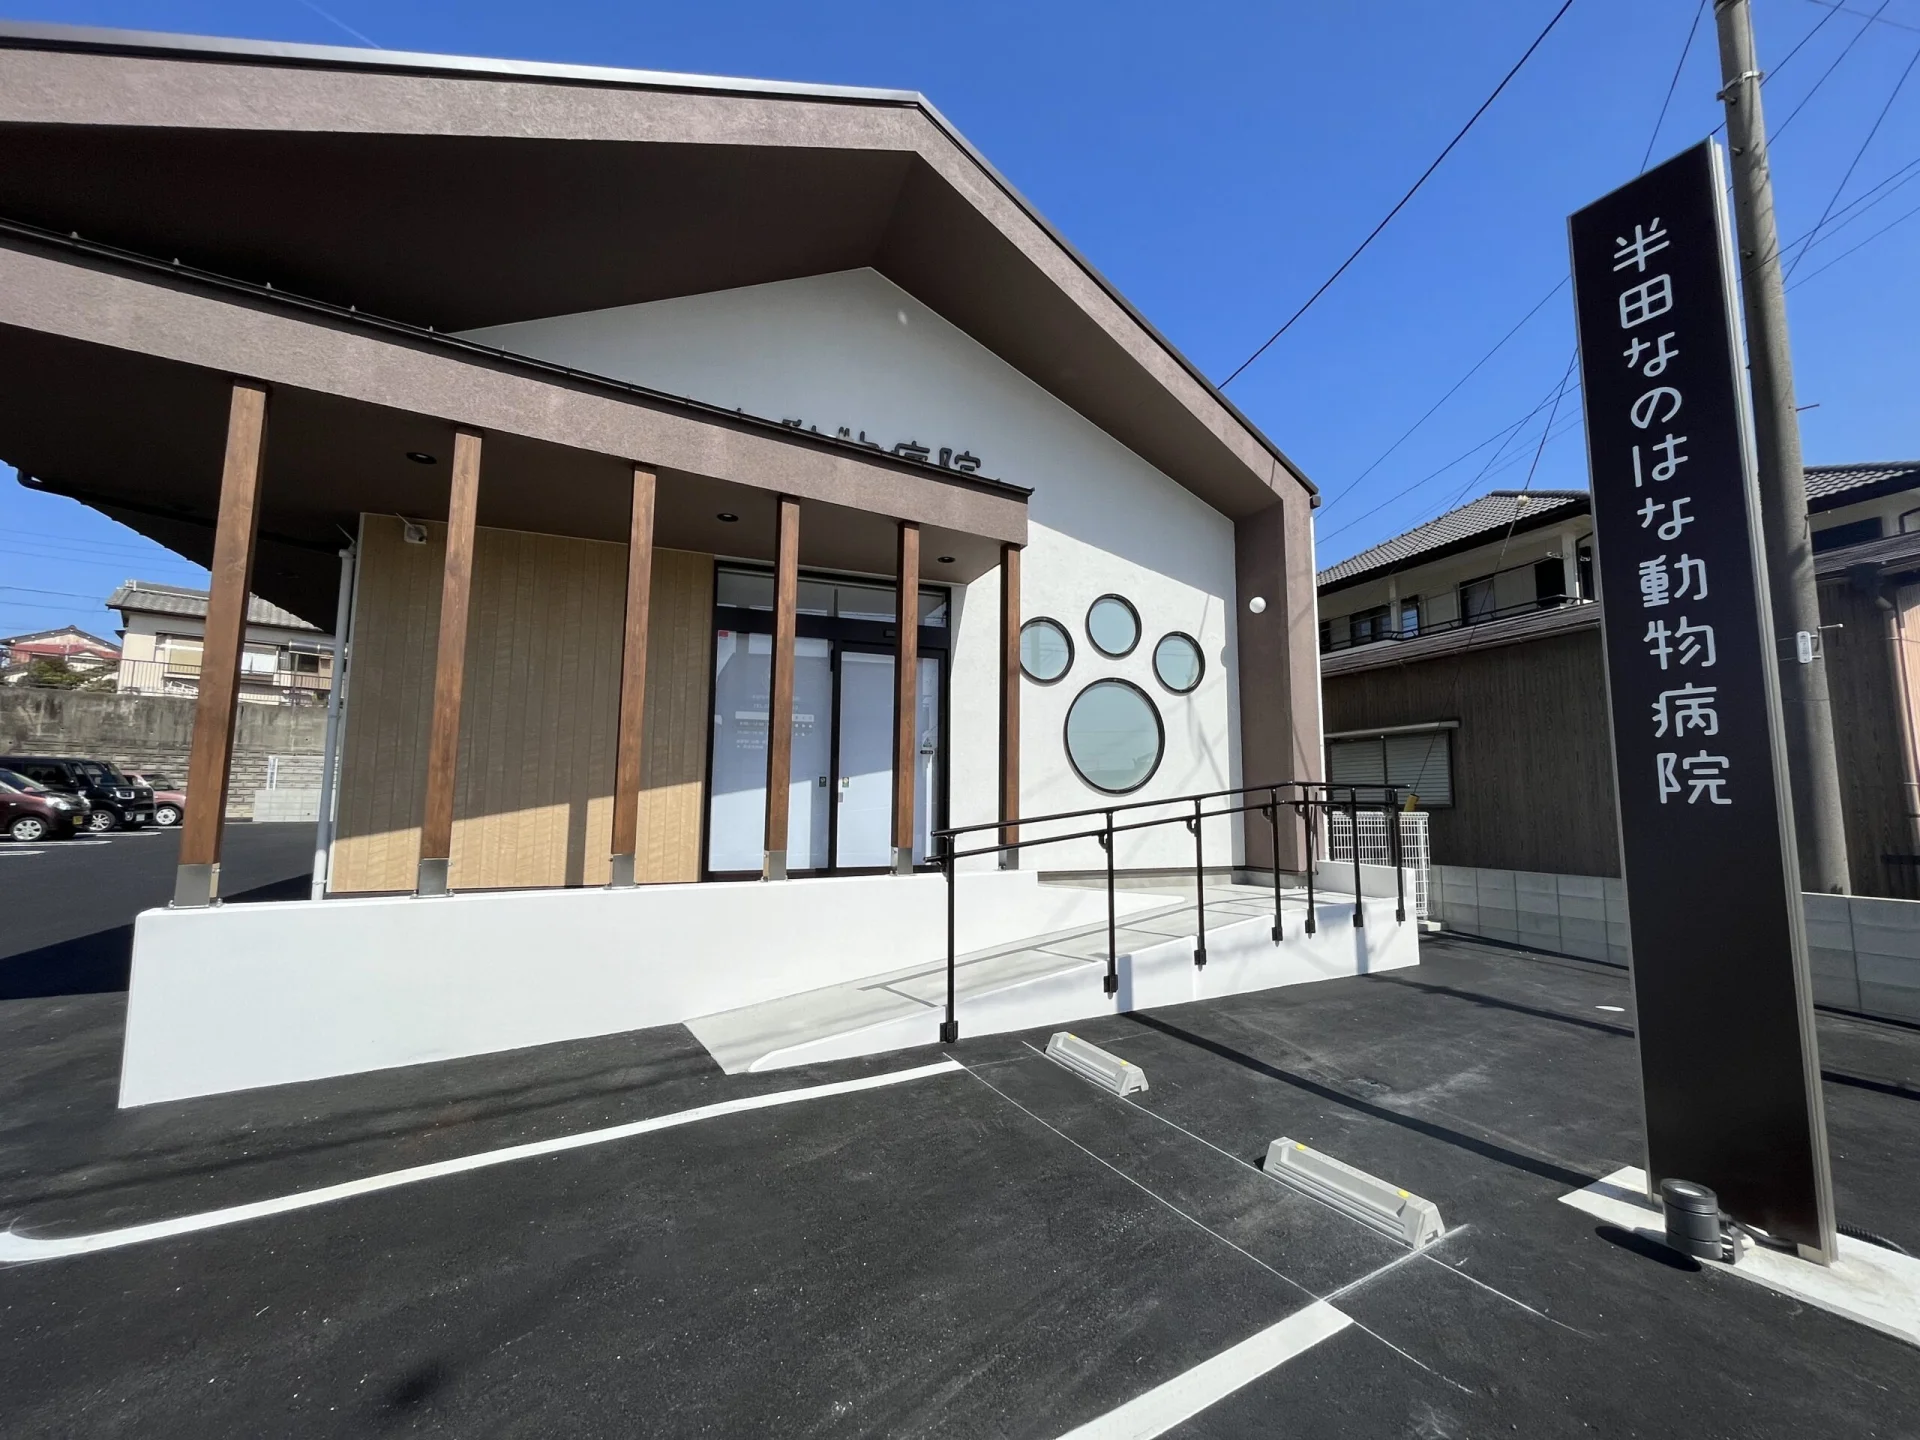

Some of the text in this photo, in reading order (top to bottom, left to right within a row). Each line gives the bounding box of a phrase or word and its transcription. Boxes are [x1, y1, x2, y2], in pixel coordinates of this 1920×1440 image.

[1612, 216, 1733, 806] 半田なのはな動物病院
